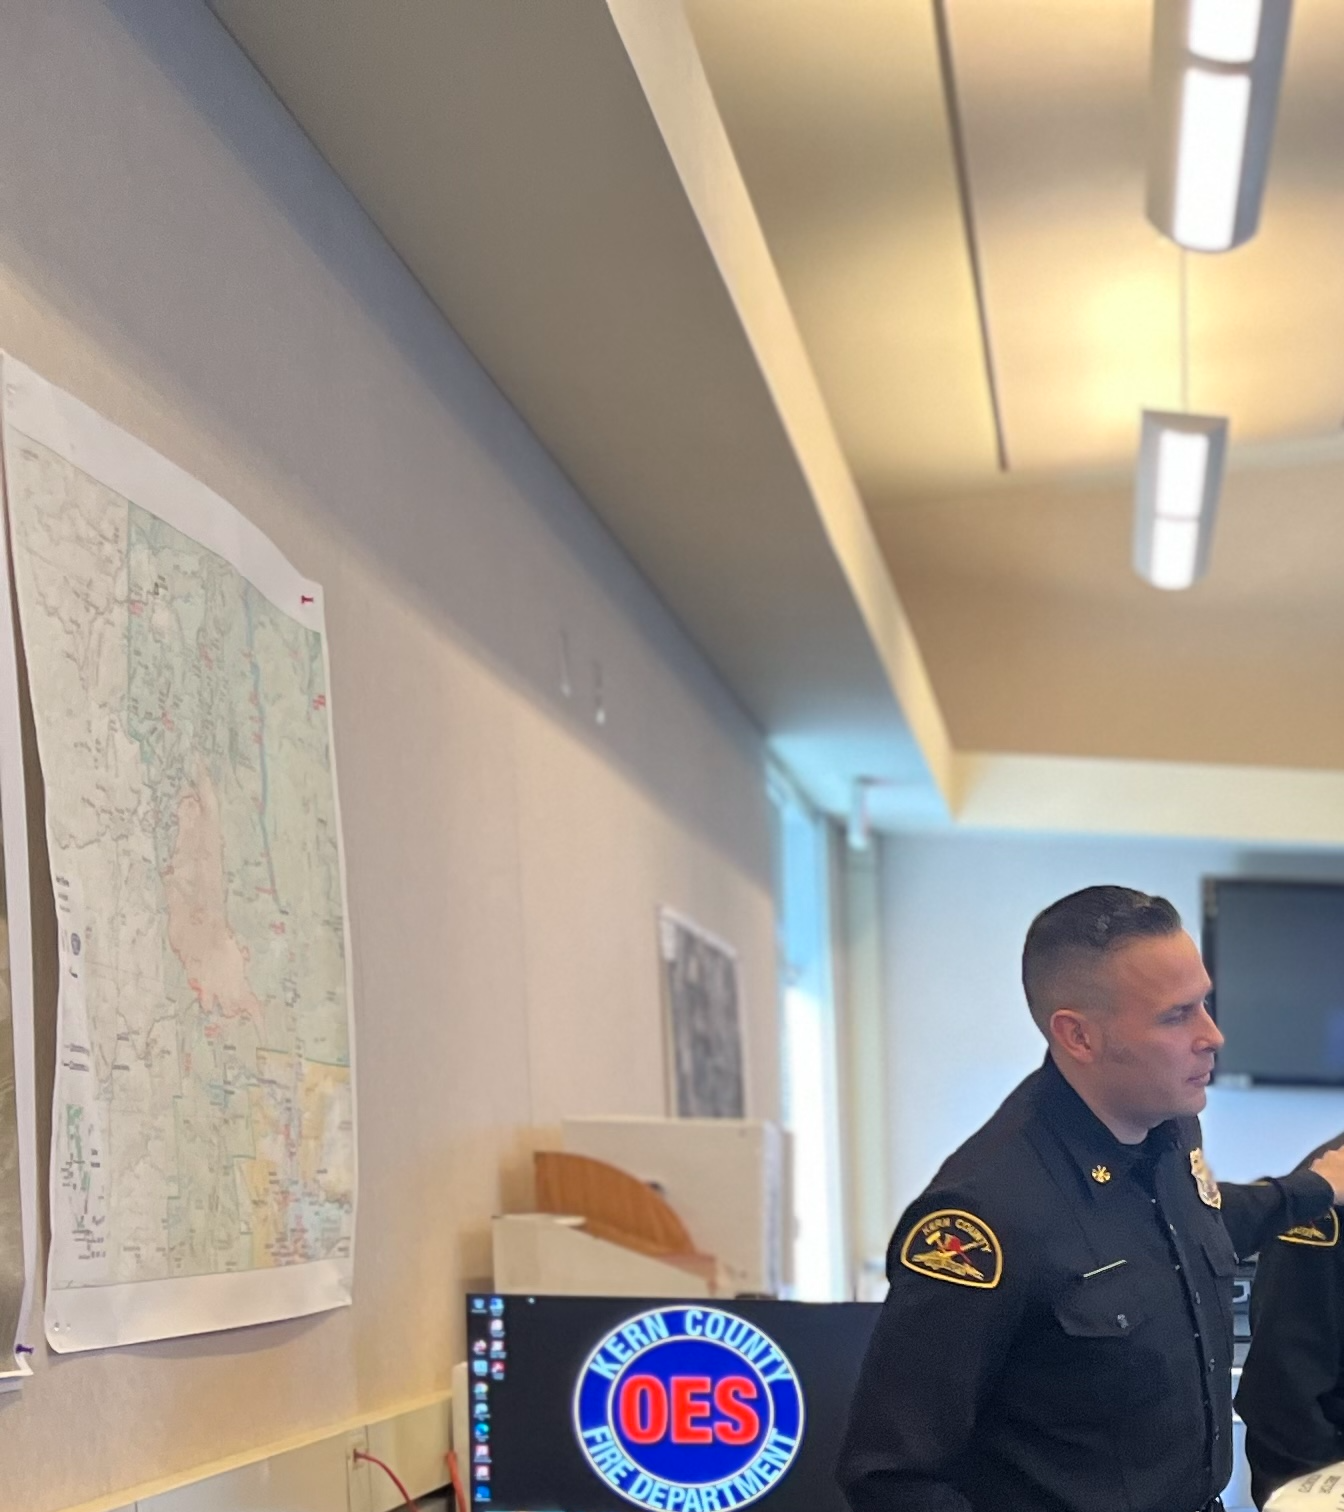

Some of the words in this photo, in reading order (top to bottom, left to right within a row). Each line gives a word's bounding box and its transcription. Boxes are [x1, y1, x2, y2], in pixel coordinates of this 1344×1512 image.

[589, 1311, 669, 1381] KERN
[684, 1309, 792, 1385] COUNTY
[619, 1375, 761, 1445] OES
[583, 1425, 630, 1486] FIRE
[627, 1427, 797, 1512] DEPARTMENT
